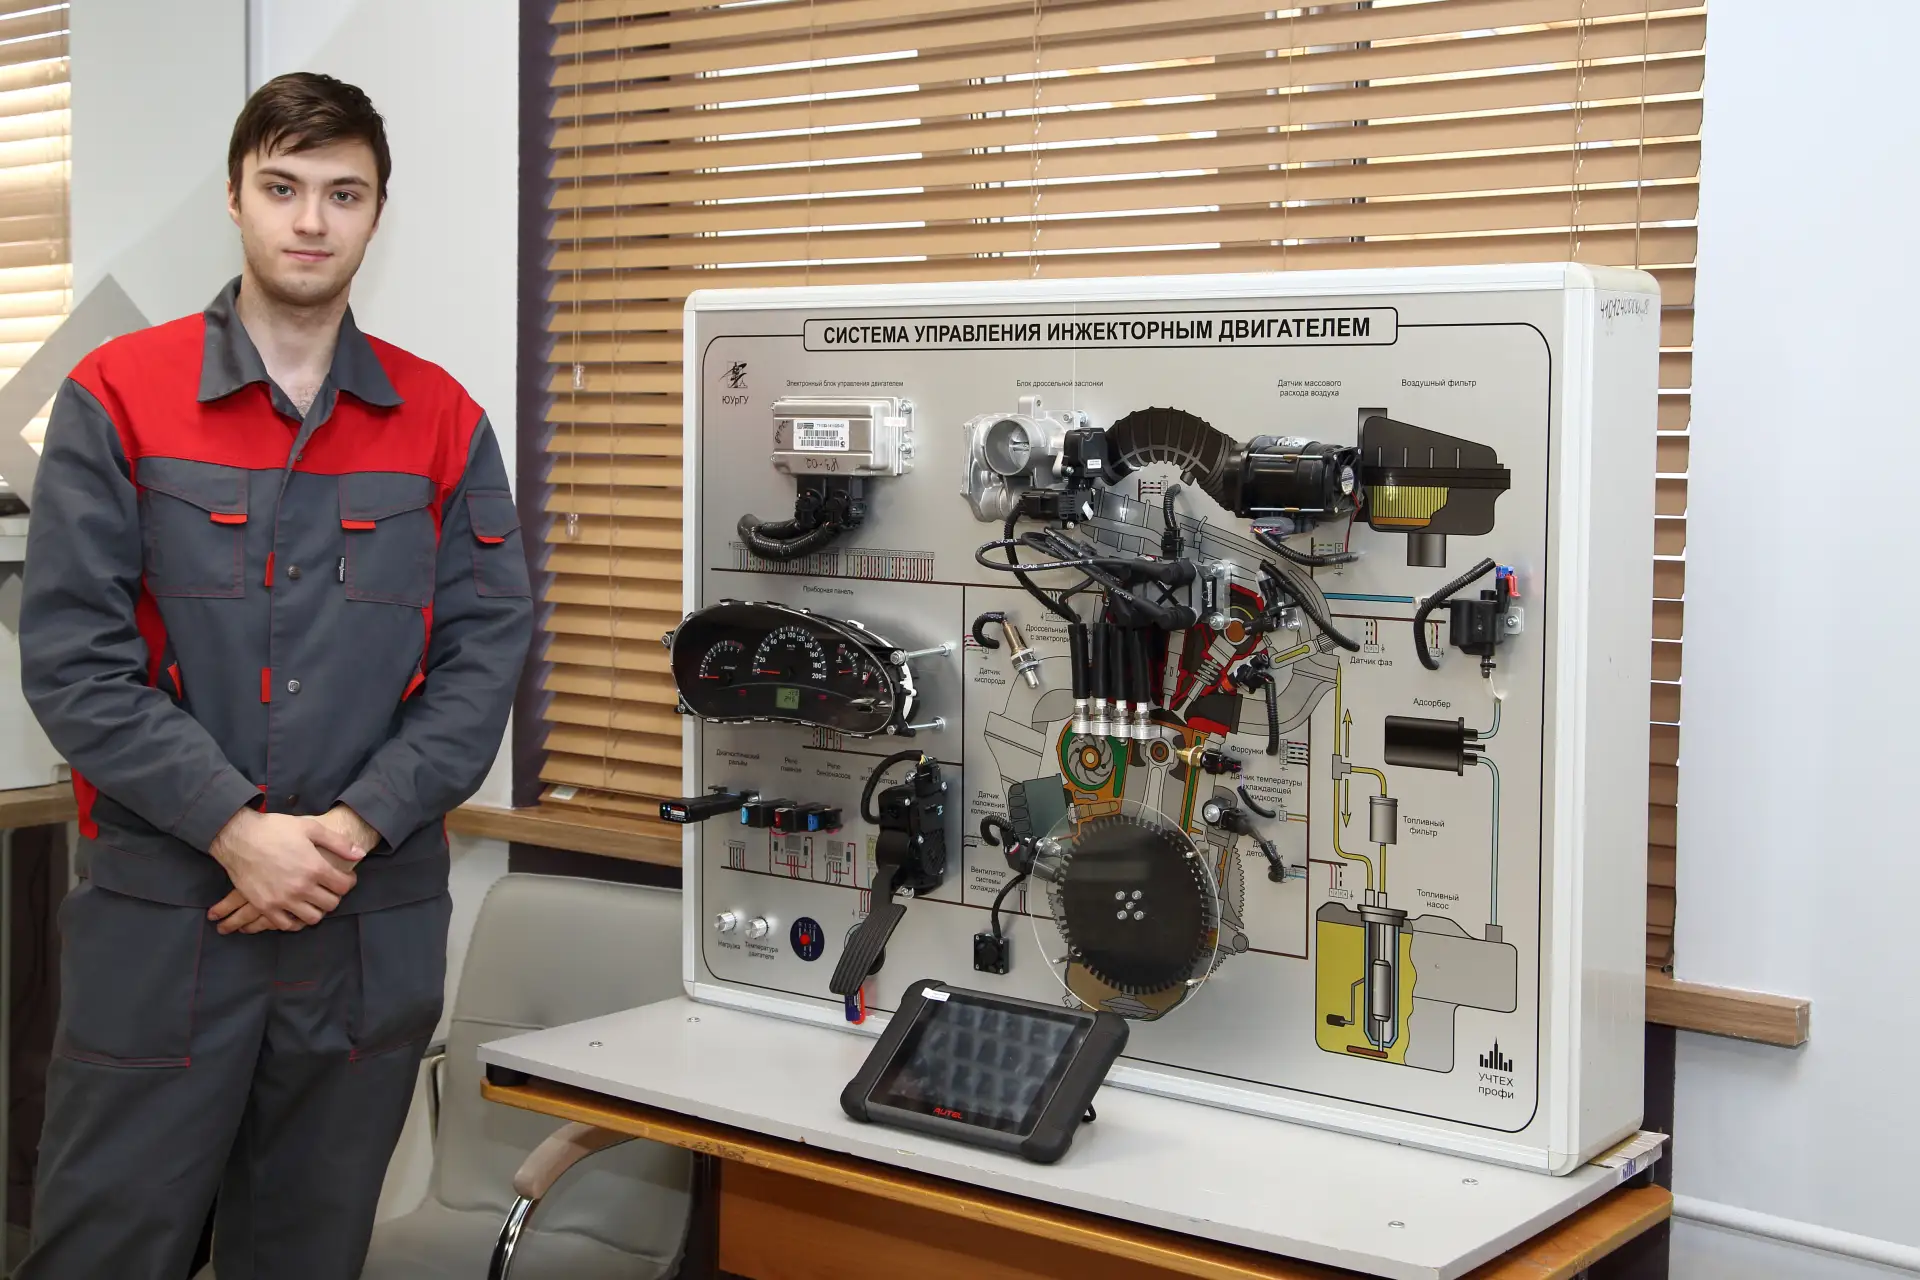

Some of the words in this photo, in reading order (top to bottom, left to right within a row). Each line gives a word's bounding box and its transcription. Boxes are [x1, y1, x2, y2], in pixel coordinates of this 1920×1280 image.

[824, 325, 909, 344] СИСТЕМА
[914, 323, 1041, 343] УПРАВЛЕНИЯ
[1047, 320, 1212, 341] ИНЖЕКТОРНЫМ
[1218, 317, 1370, 342] ДВИГАТЕЛЕМ
[786, 379, 822, 388] Электронный
[823, 379, 836, 387] блок
[837, 381, 870, 389] управления
[1016, 379, 1031, 387] Блок
[1032, 379, 1073, 387] дроссельной
[1277, 379, 1303, 388] Датчик
[1304, 379, 1342, 387] массового
[1401, 378, 1446, 388] Воздушный
[1447, 378, 1477, 388] фильтр
[1279, 389, 1309, 397] расхода
[1310, 389, 1340, 397] воздуха
[722, 395, 749, 406] ЮУрГУ
[803, 585, 834, 594] Приборная
[834, 588, 854, 596] панель
[1025, 624, 1068, 634] Дроссельный
[1350, 655, 1376, 665] Датчик
[1377, 658, 1393, 666] фаз
[980, 667, 1001, 676] Датчик
[974, 677, 1006, 685] кислорода
[1413, 697, 1451, 709] Адсорбер
[716, 748, 760, 760] Диагностический
[1230, 745, 1264, 755] Форсунки
[784, 756, 799, 765] Реле
[826, 761, 841, 770] Реле
[1256, 775, 1303, 788] температуры
[978, 790, 999, 800] Датчик
[972, 799, 1006, 809] положения
[970, 808, 1007, 818] коленчатого
[1403, 815, 1445, 828] Топливный
[1409, 826, 1438, 838] фильтр
[970, 866, 1006, 878] Вентилятор
[975, 876, 1001, 885] системы
[1417, 888, 1460, 901] Топливный
[1426, 900, 1450, 910] насос
[718, 940, 741, 951] Нагрузка
[745, 941, 779, 953] Температура
[748, 950, 775, 960] двигателя
[1478, 1072, 1514, 1088] УЧТЕХ
[1478, 1086, 1514, 1100] профи
